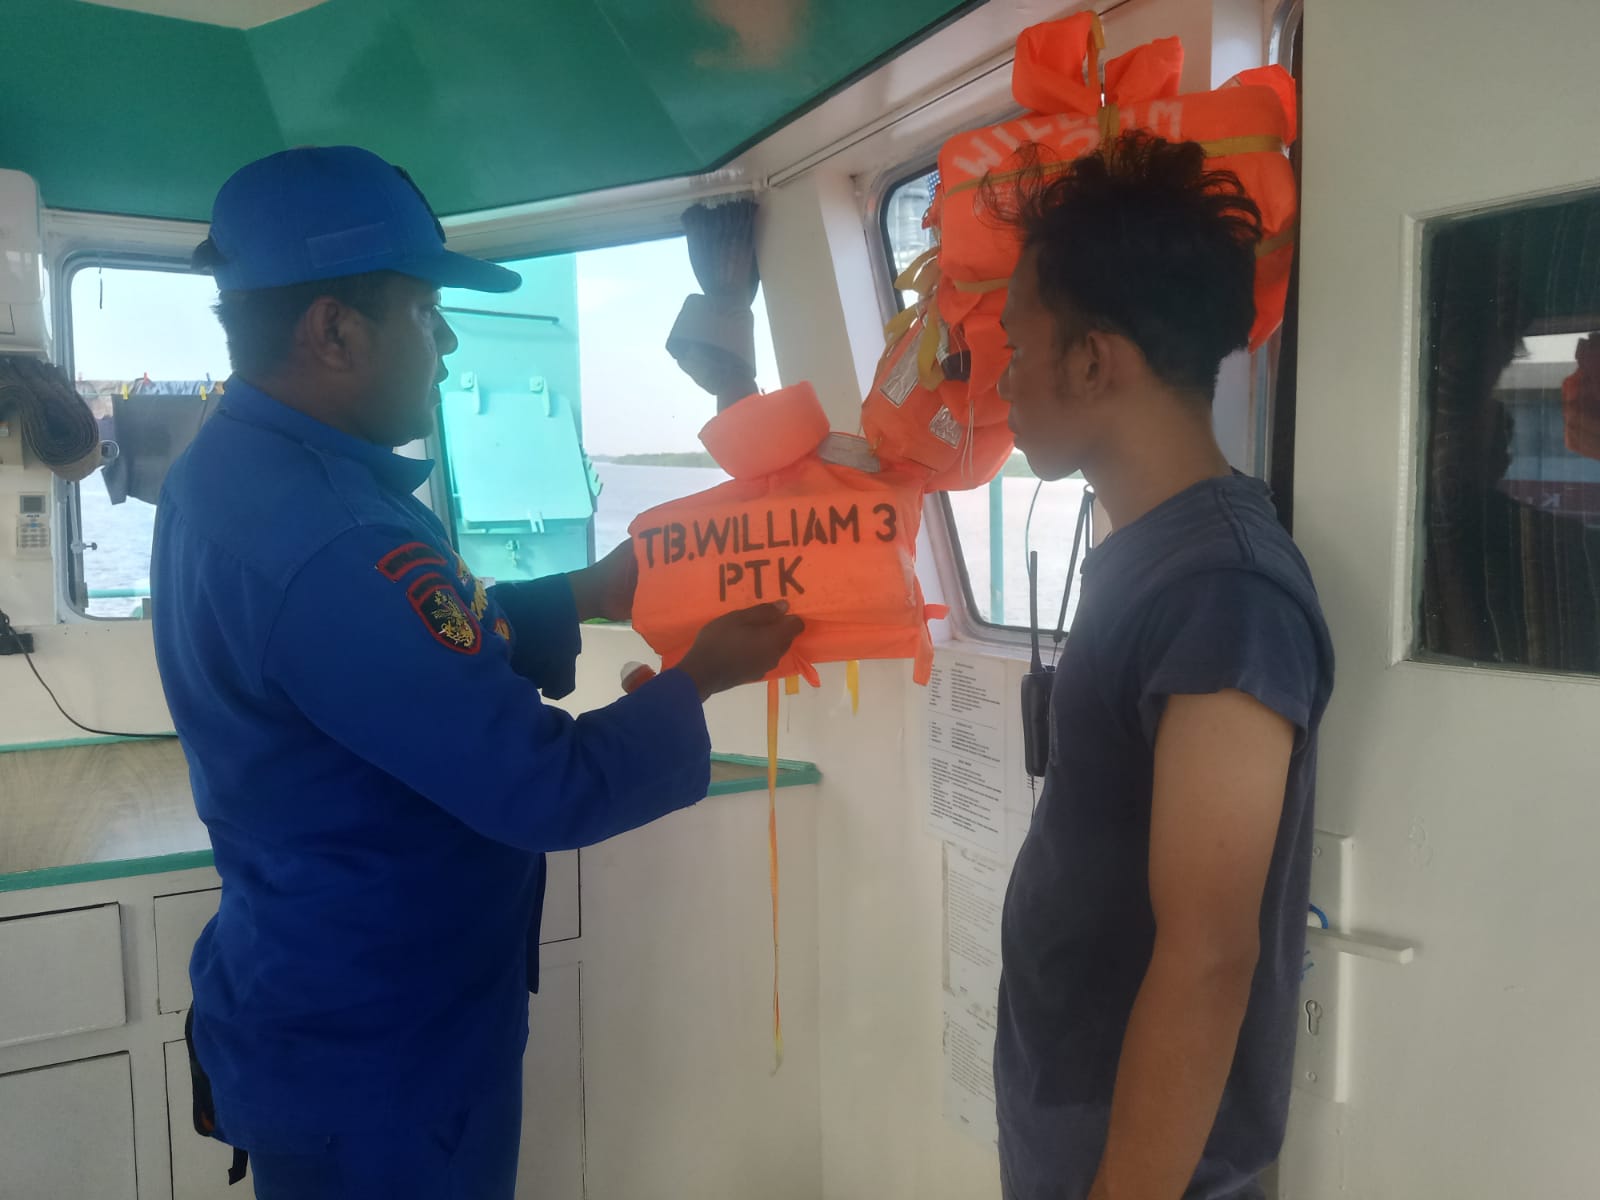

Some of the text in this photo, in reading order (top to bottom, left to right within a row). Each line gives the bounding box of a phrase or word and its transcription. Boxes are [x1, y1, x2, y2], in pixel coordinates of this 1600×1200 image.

[638, 503, 897, 569] TB.WILLIAM 3
[719, 556, 805, 602] PTK
